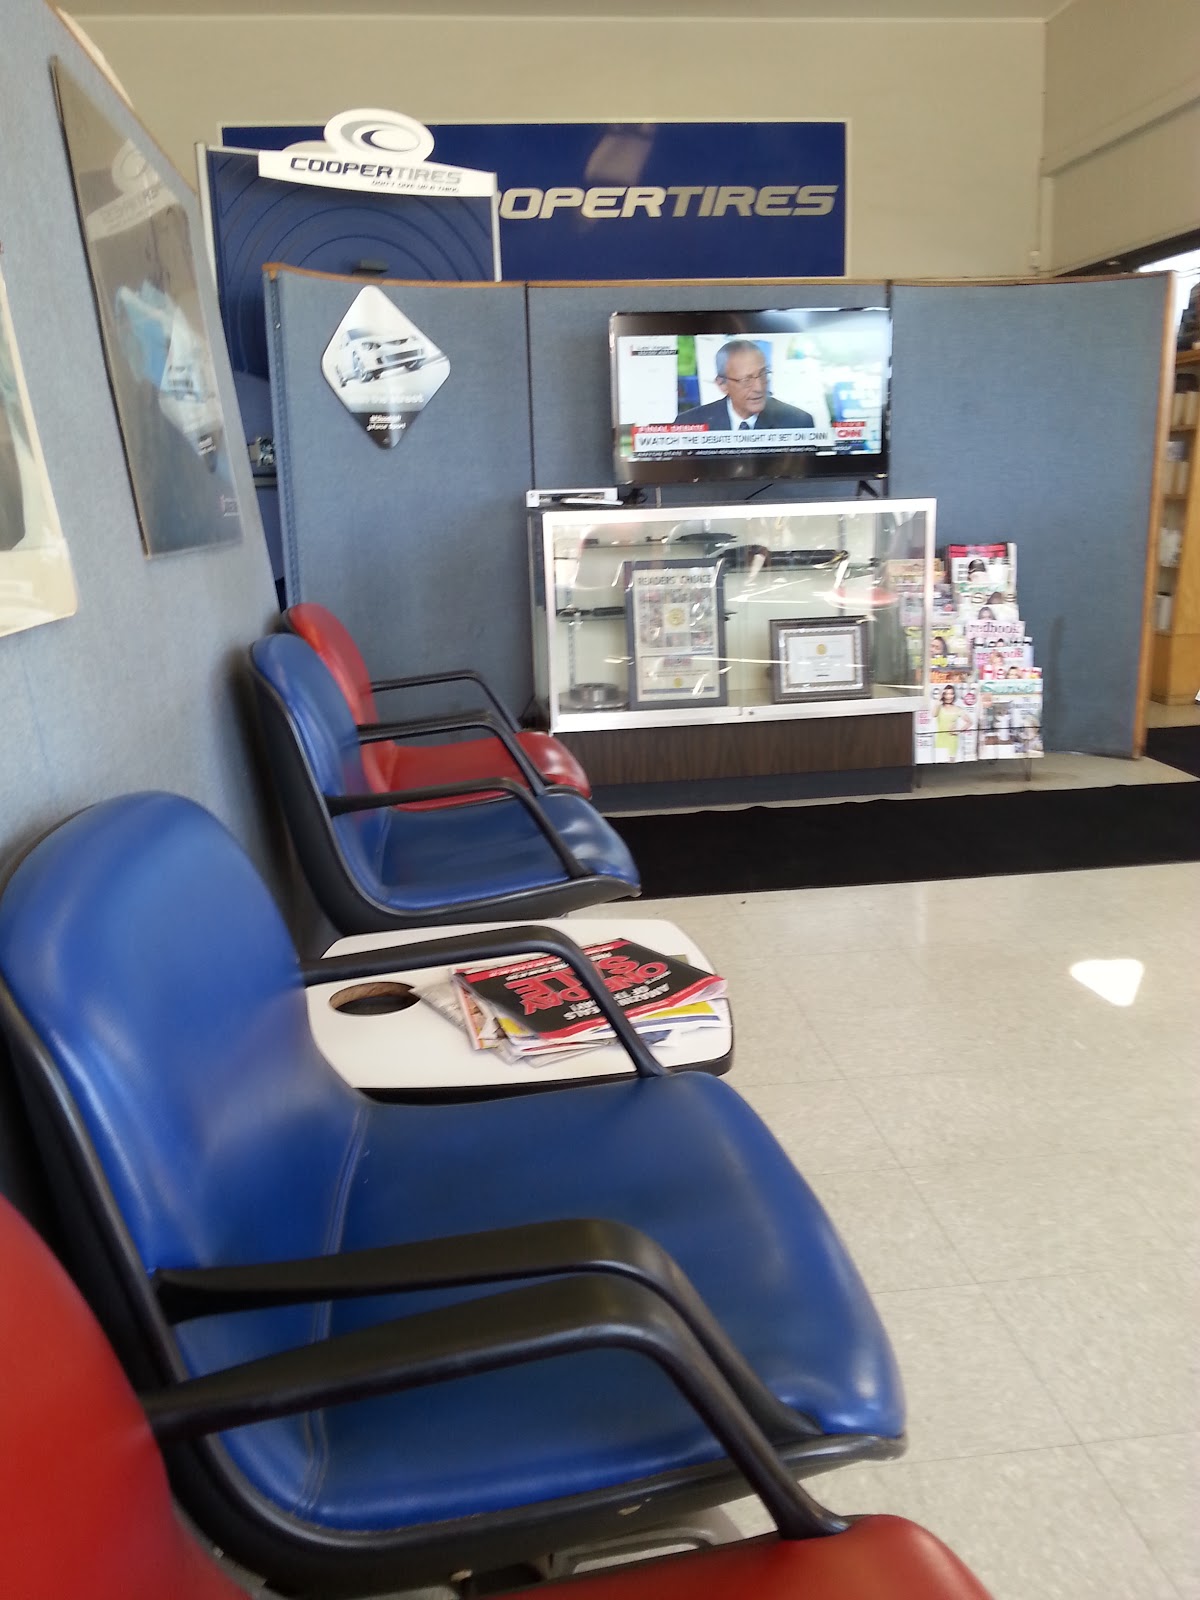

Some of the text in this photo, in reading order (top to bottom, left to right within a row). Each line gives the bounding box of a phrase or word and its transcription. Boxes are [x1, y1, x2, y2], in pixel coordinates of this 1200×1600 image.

[498, 184, 839, 219] OPERTIRES
[638, 436, 679, 446] WATCH
[682, 436, 698, 445] THE
[701, 435, 731, 444] DEBATE
[733, 434, 764, 443] TONIGHT
[767, 433, 777, 441] AT
[794, 432, 806, 441] ON
[808, 431, 829, 441] CNN
[837, 429, 863, 438] CNN
[603, 962, 669, 993] ONE
[520, 983, 591, 1015] DAY
[563, 983, 670, 1020] AMAZIN EALS
